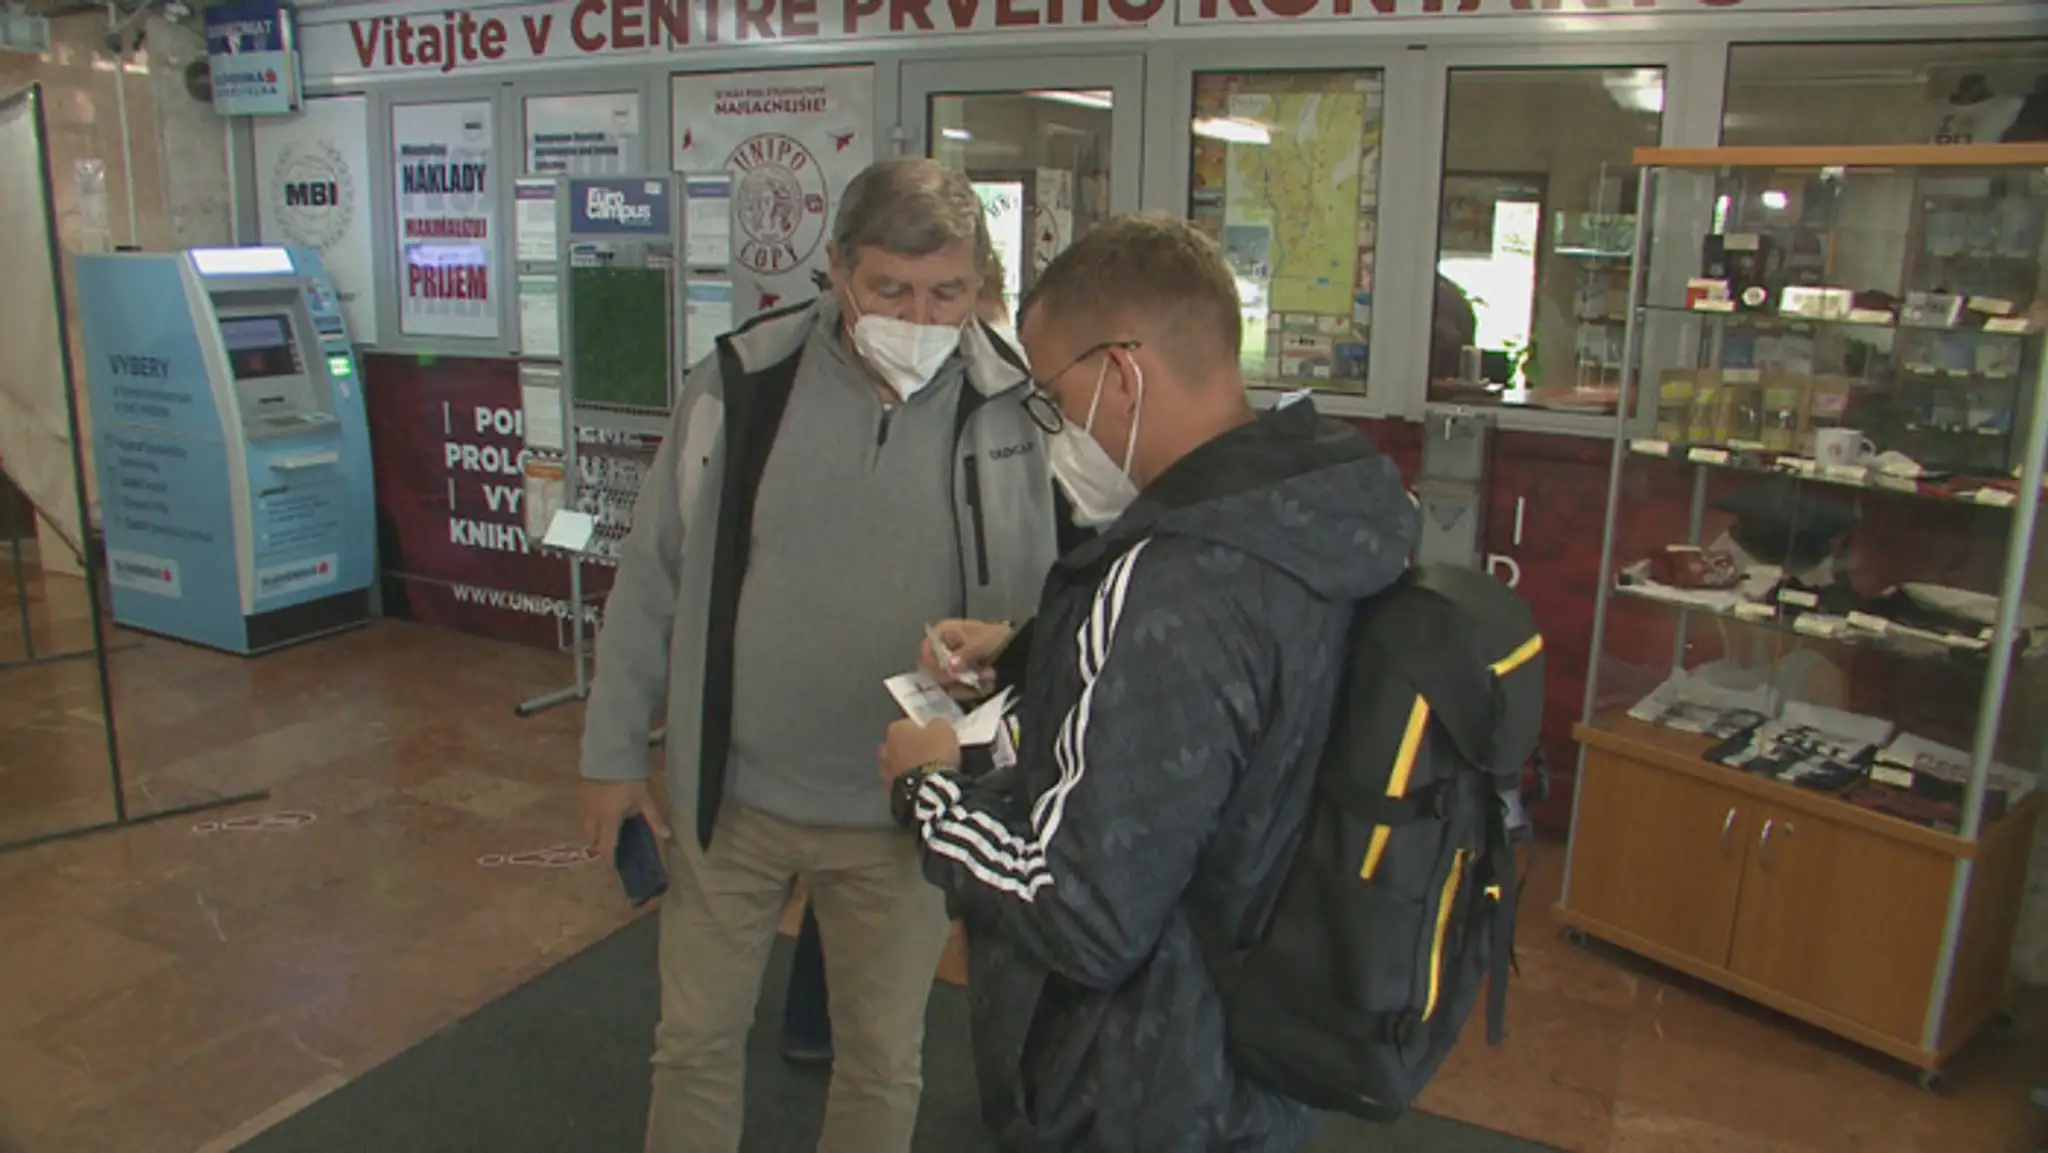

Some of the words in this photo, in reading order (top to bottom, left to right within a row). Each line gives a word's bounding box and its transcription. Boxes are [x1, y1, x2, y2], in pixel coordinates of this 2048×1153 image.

[349, 9, 508, 74] Vitajte
[521, 14, 553, 56] v
[571, 0, 820, 51] CENTRE
[734, 137, 807, 172] UNIPO
[285, 181, 339, 207] MBI
[453, 583, 600, 624] WWW.UNIPO.K
